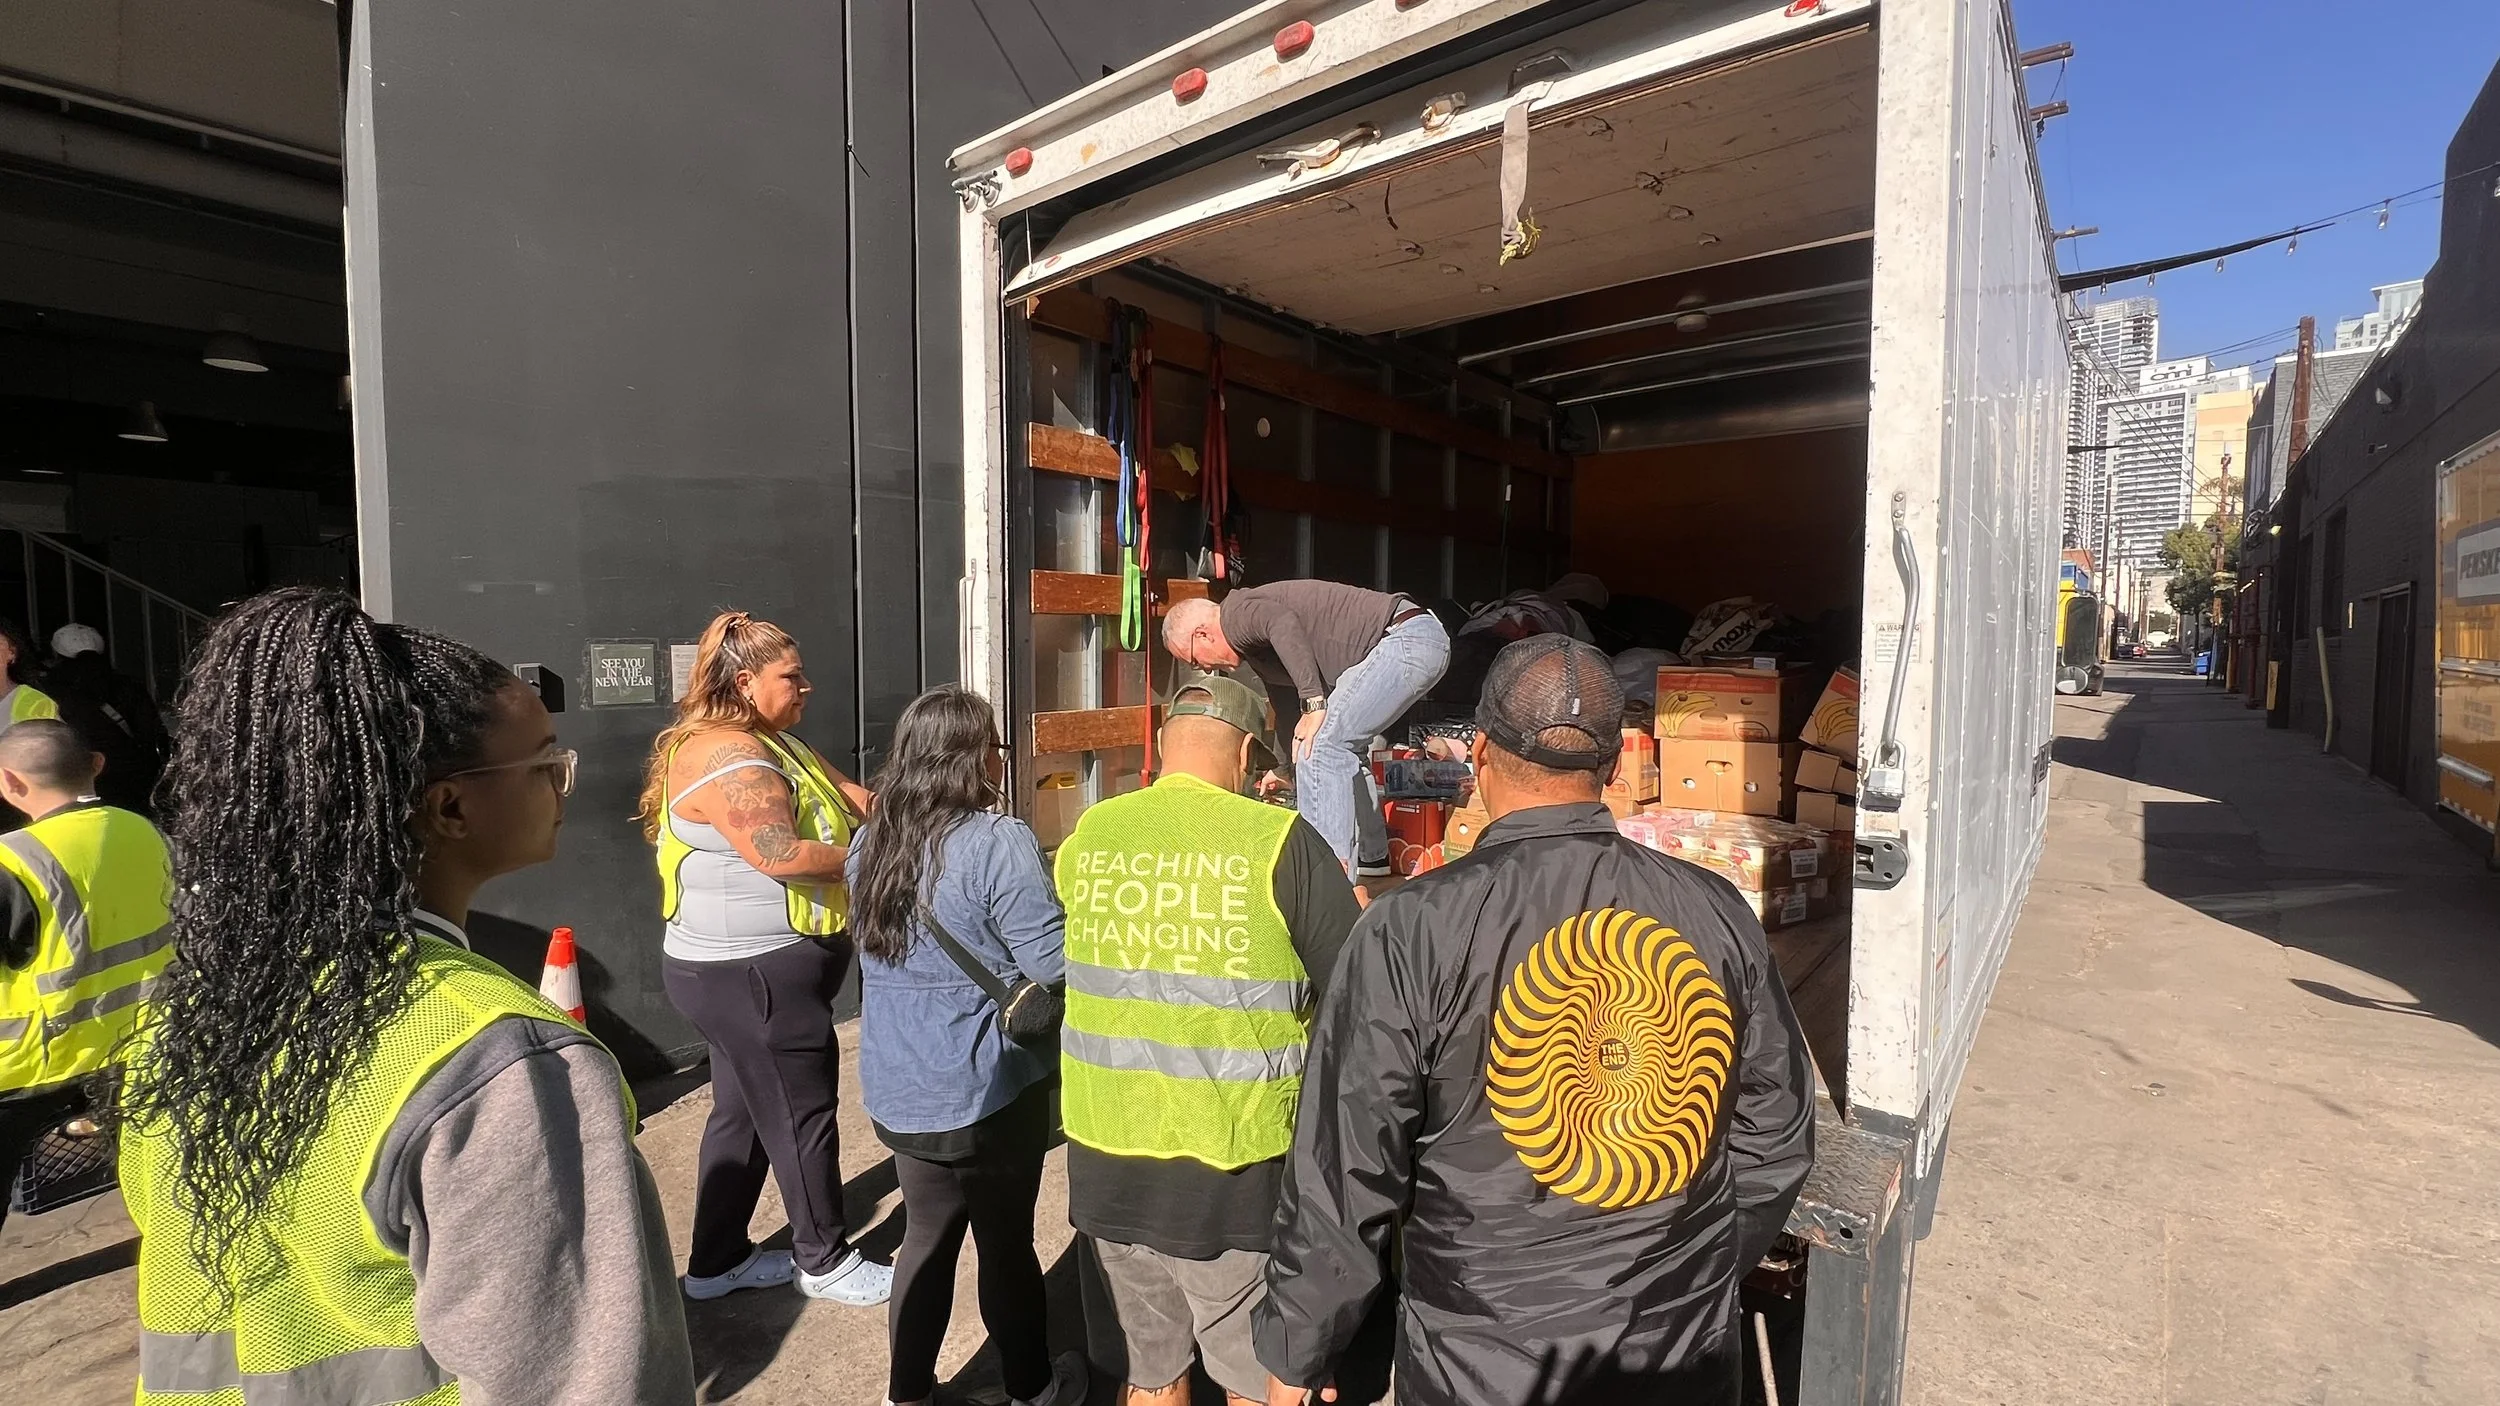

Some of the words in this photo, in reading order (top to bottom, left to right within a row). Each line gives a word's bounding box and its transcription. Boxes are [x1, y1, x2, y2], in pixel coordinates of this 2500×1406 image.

[601, 658, 622, 669] SEE
[623, 658, 645, 669] YOU
[606, 668, 620, 678] IN
[621, 668, 642, 677] THE
[595, 677, 619, 688] NEW
[623, 676, 653, 687] YEAR
[1076, 850, 1250, 881] REACHING
[1072, 879, 1249, 921] PEOPLE
[1070, 917, 1250, 954] CHANGING
[1601, 1042, 1625, 1055] THE
[1602, 1054, 1627, 1066] END
